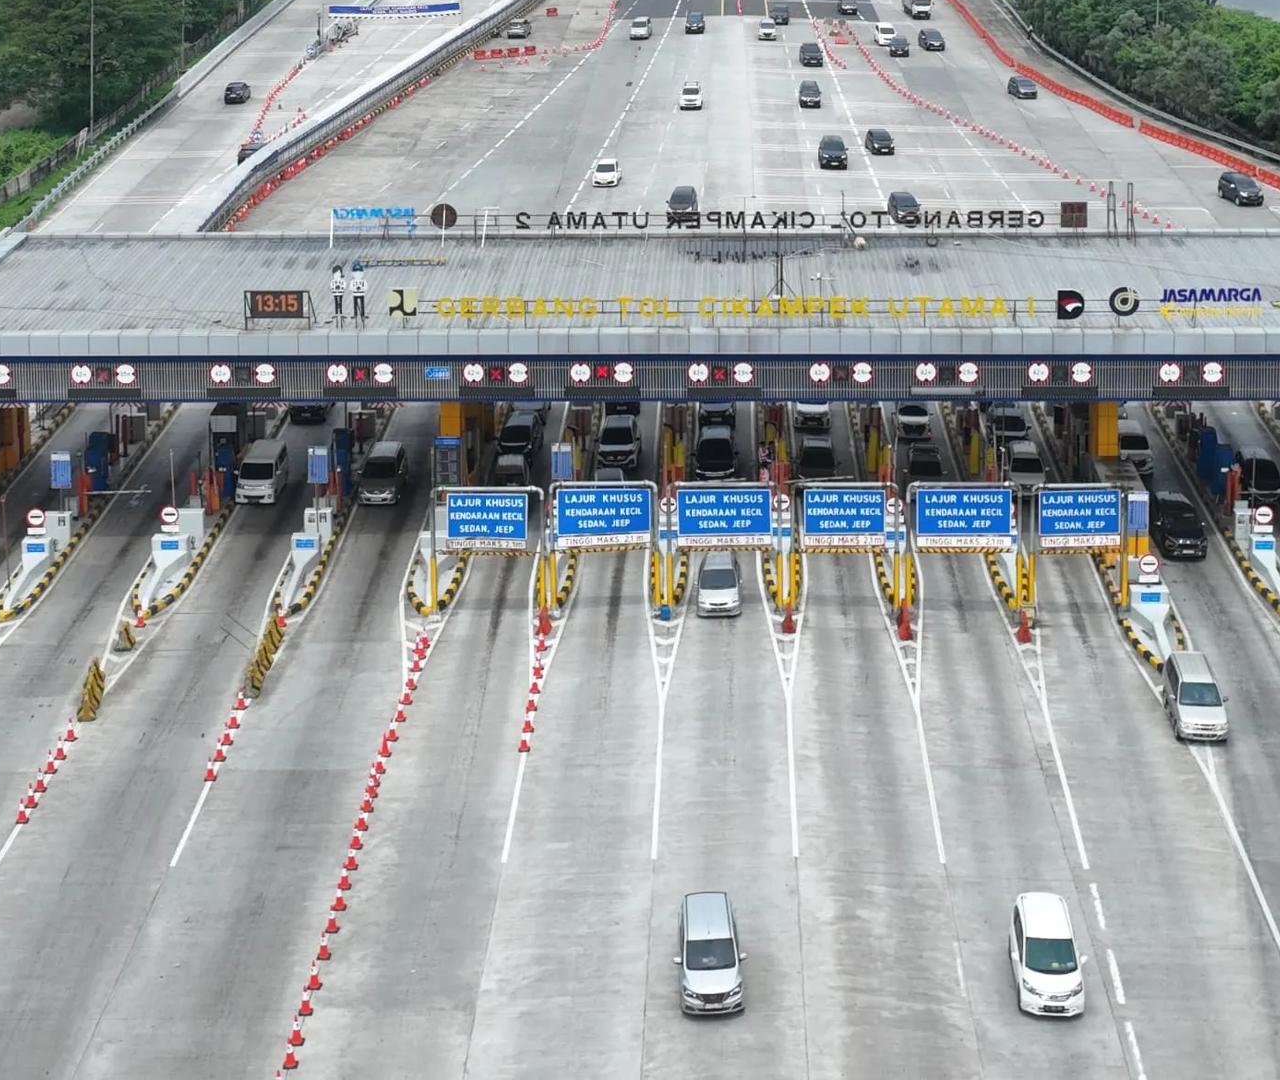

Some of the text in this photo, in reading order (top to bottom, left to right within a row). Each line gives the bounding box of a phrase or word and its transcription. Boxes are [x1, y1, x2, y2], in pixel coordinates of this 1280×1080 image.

[1160, 287, 1262, 302] JASAMARGA
[256, 294, 298, 312] 13:15
[437, 296, 598, 318] GERBANG
[616, 296, 680, 318] TOL
[698, 296, 870, 318] CIKAMPEK
[889, 296, 1008, 318] UTAMA
[451, 499, 523, 507] LAJUR KHUSUS
[565, 494, 642, 503] LAJUR KHUSUS
[686, 495, 763, 504] LAJUR KHUSUS
[843, 495, 881, 503] KHUSUS
[925, 495, 1003, 503] LAJUR KHUSUS
[1043, 495, 1116, 504] LAJUR KHUSUS
[566, 507, 642, 516] KENDARAAN KECIL
[686, 508, 762, 517] KENDARAAN KECIL
[925, 508, 976, 516] KENDARAAN
[1042, 508, 1116, 517] KENDARAAN KECIL
[612, 519, 630, 527] JEEP
[733, 520, 751, 528] JEEP
[972, 520, 991, 528] JEEP
